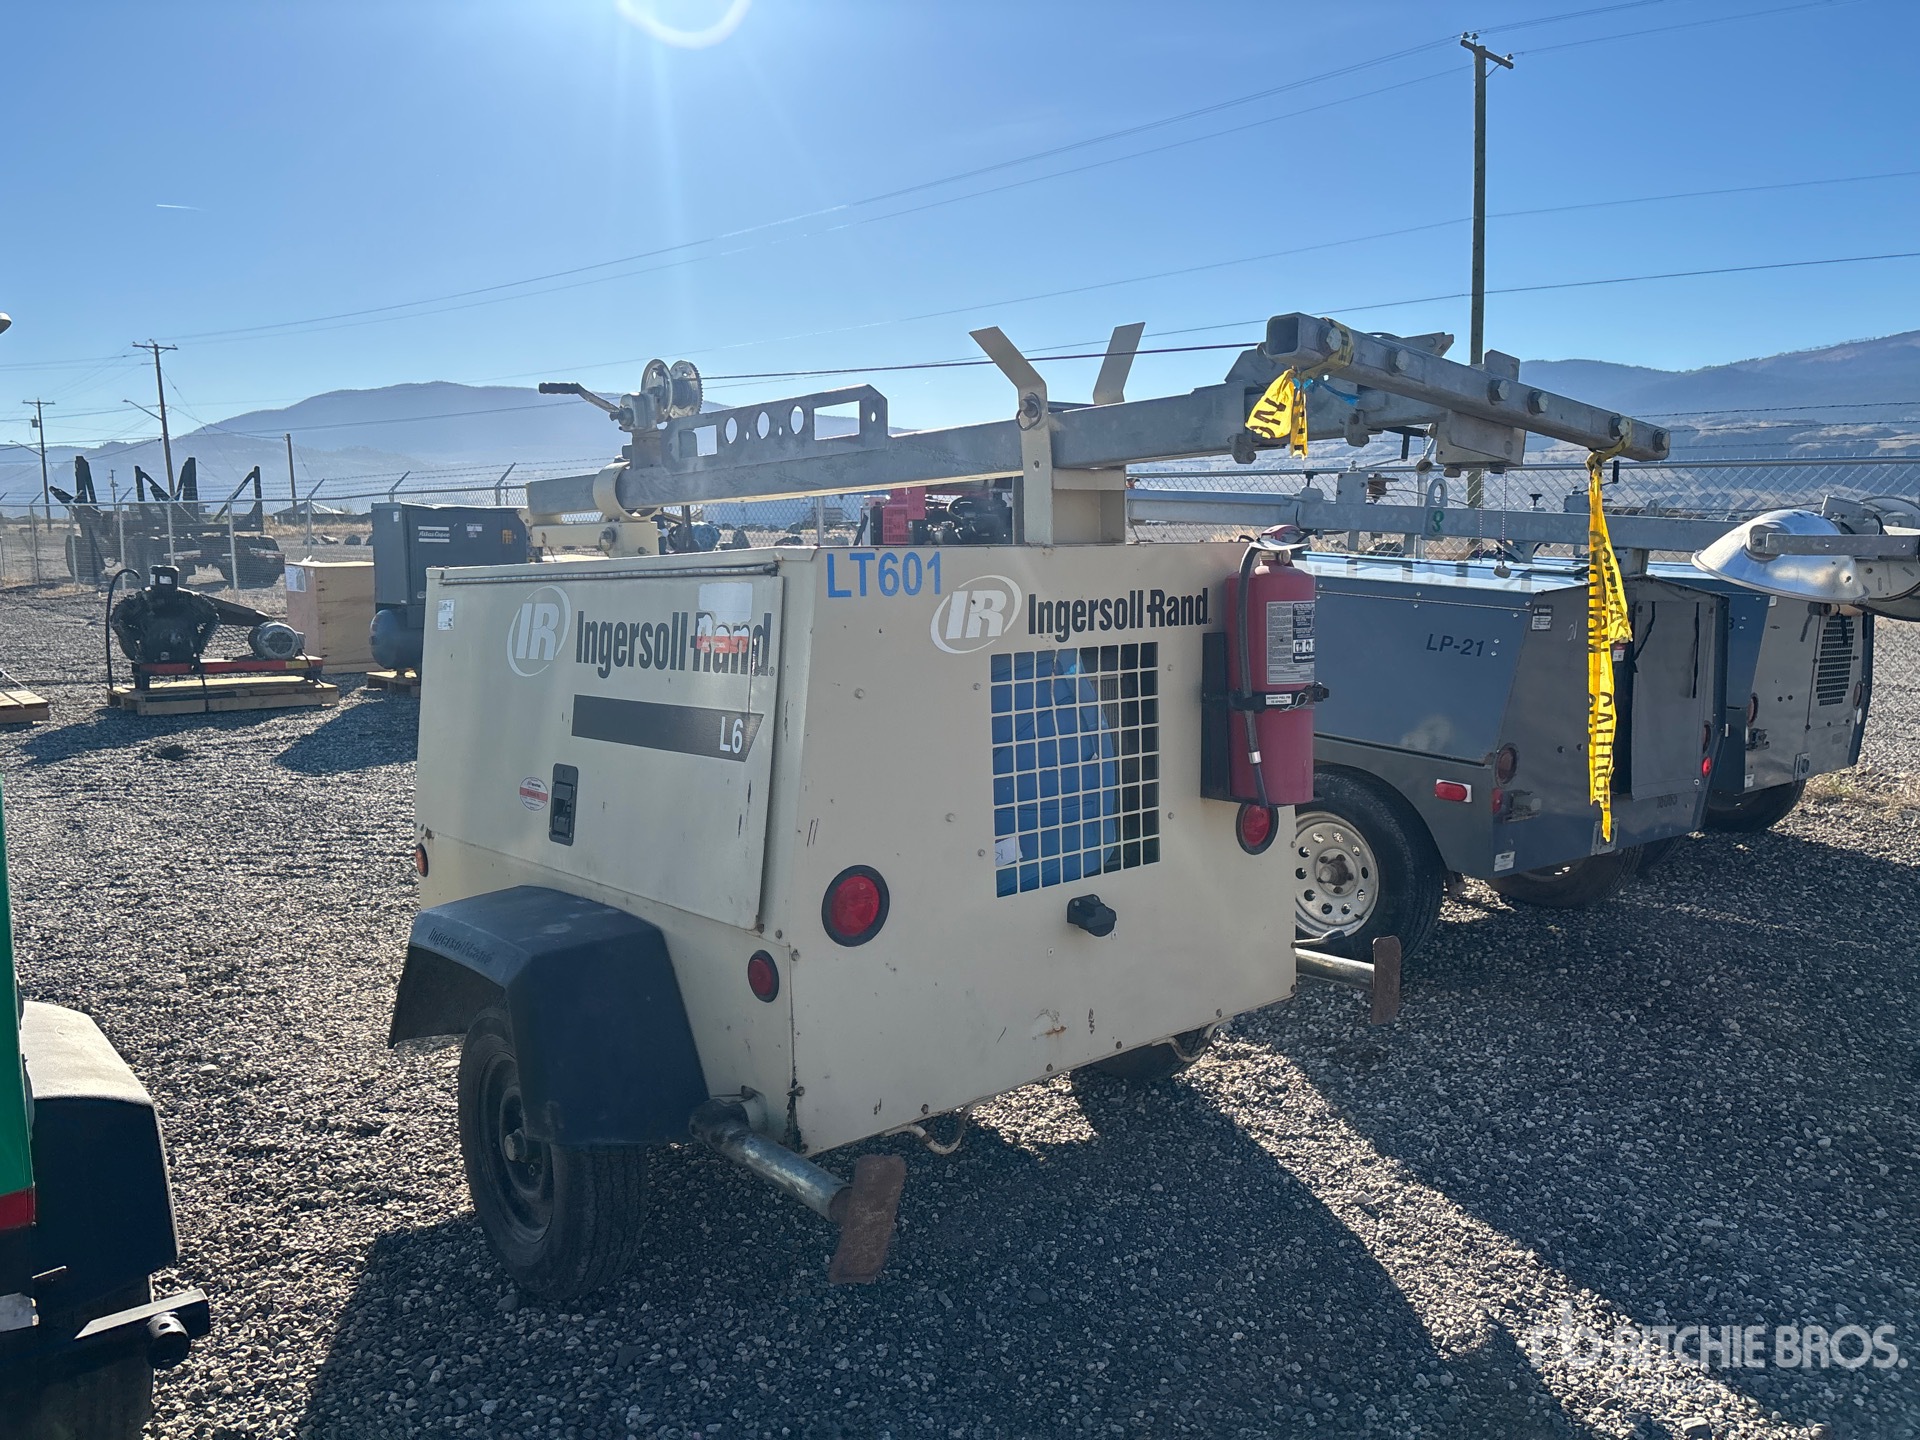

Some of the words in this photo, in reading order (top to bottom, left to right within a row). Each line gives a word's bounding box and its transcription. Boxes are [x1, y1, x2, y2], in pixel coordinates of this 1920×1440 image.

[826, 551, 942, 598] LT601
[1028, 589, 1144, 643] Ingersoll
[1147, 588, 1209, 627] Rand
[576, 611, 689, 679] Ingersoll
[1426, 633, 1485, 657] LP-21
[719, 716, 744, 754] L6
